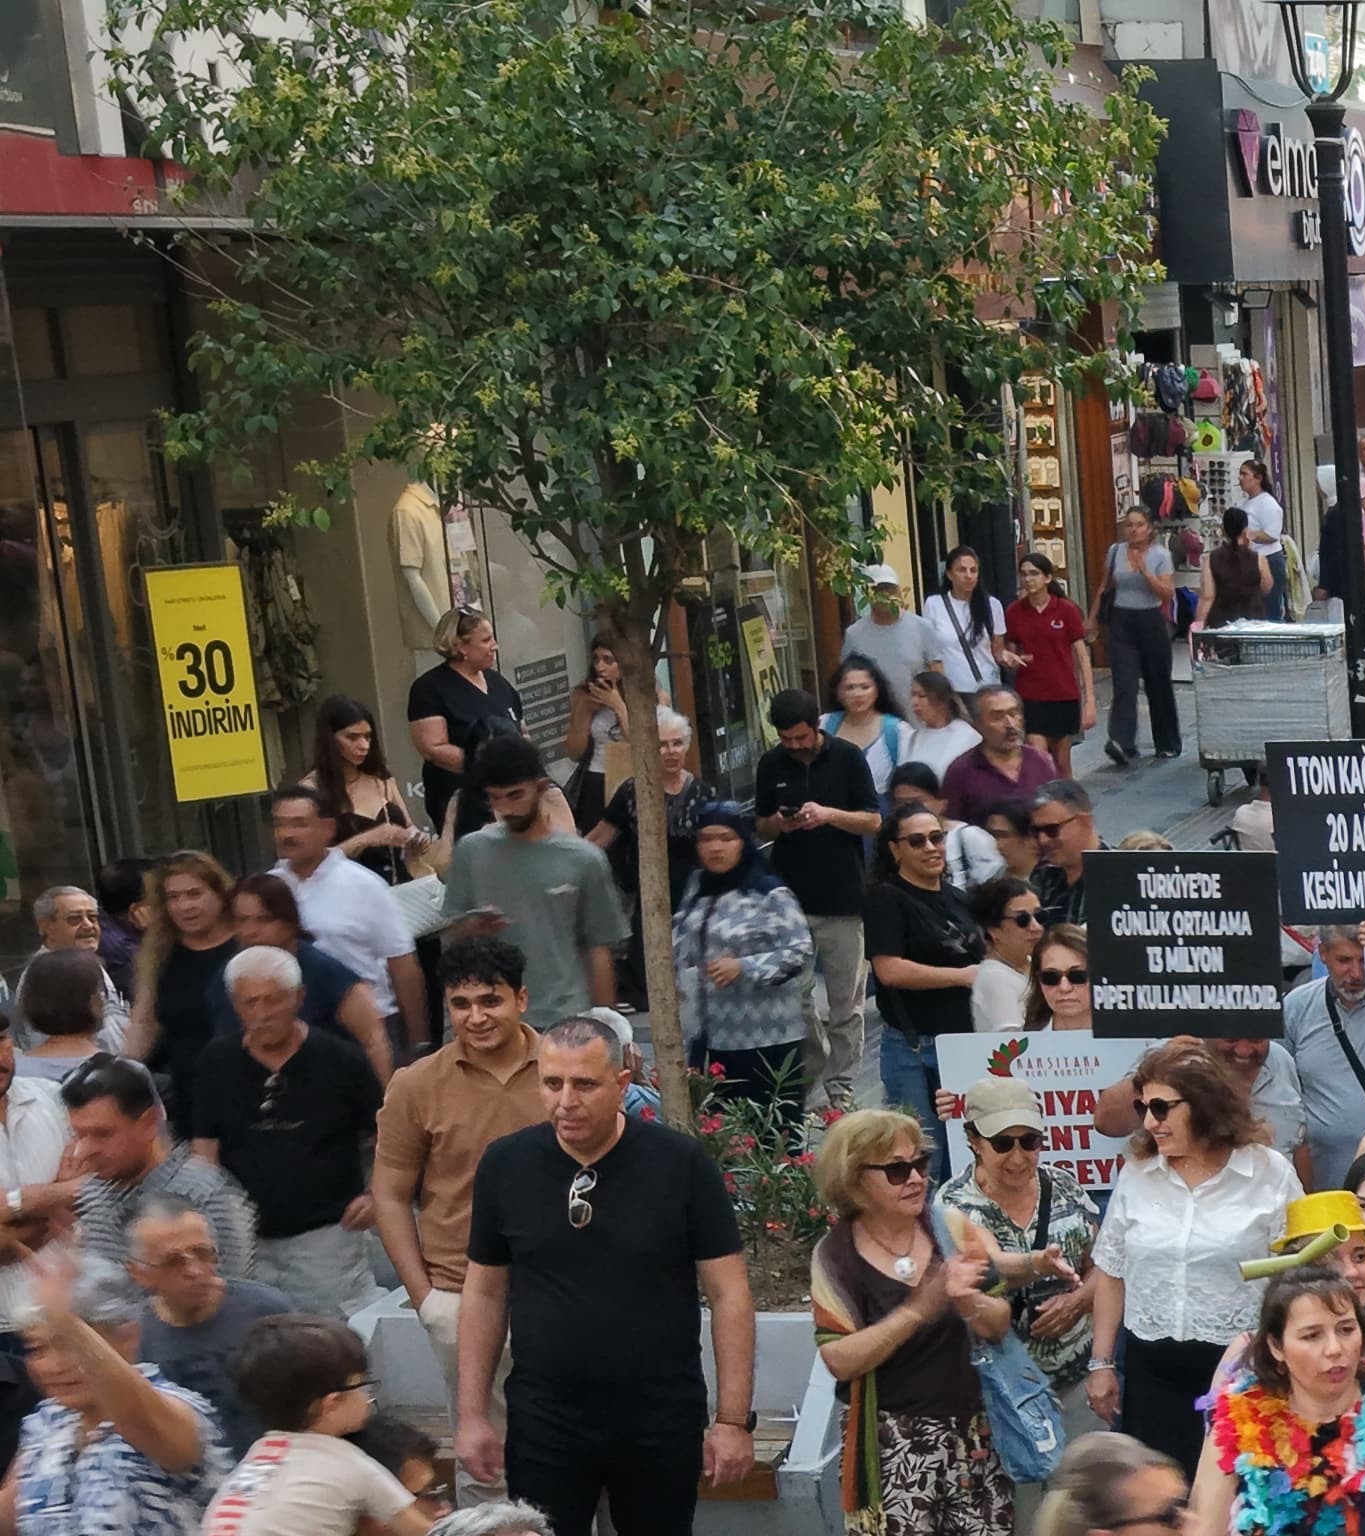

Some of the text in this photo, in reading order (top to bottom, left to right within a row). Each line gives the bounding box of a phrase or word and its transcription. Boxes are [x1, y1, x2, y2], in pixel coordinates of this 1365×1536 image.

[168, 698, 255, 739] İNDİRİM
[1286, 756, 1297, 795] 1
[1297, 755, 1337, 796] TON
[1326, 812, 1349, 853] 20
[1137, 865, 1222, 899] TÜRKİYE'DE
[1111, 904, 1253, 936] GÜNLÜK ORTALAMA
[1165, 937, 1225, 973] MİLYON
[1093, 977, 1281, 1010] PİPET KULLANILMAKTADIR.
